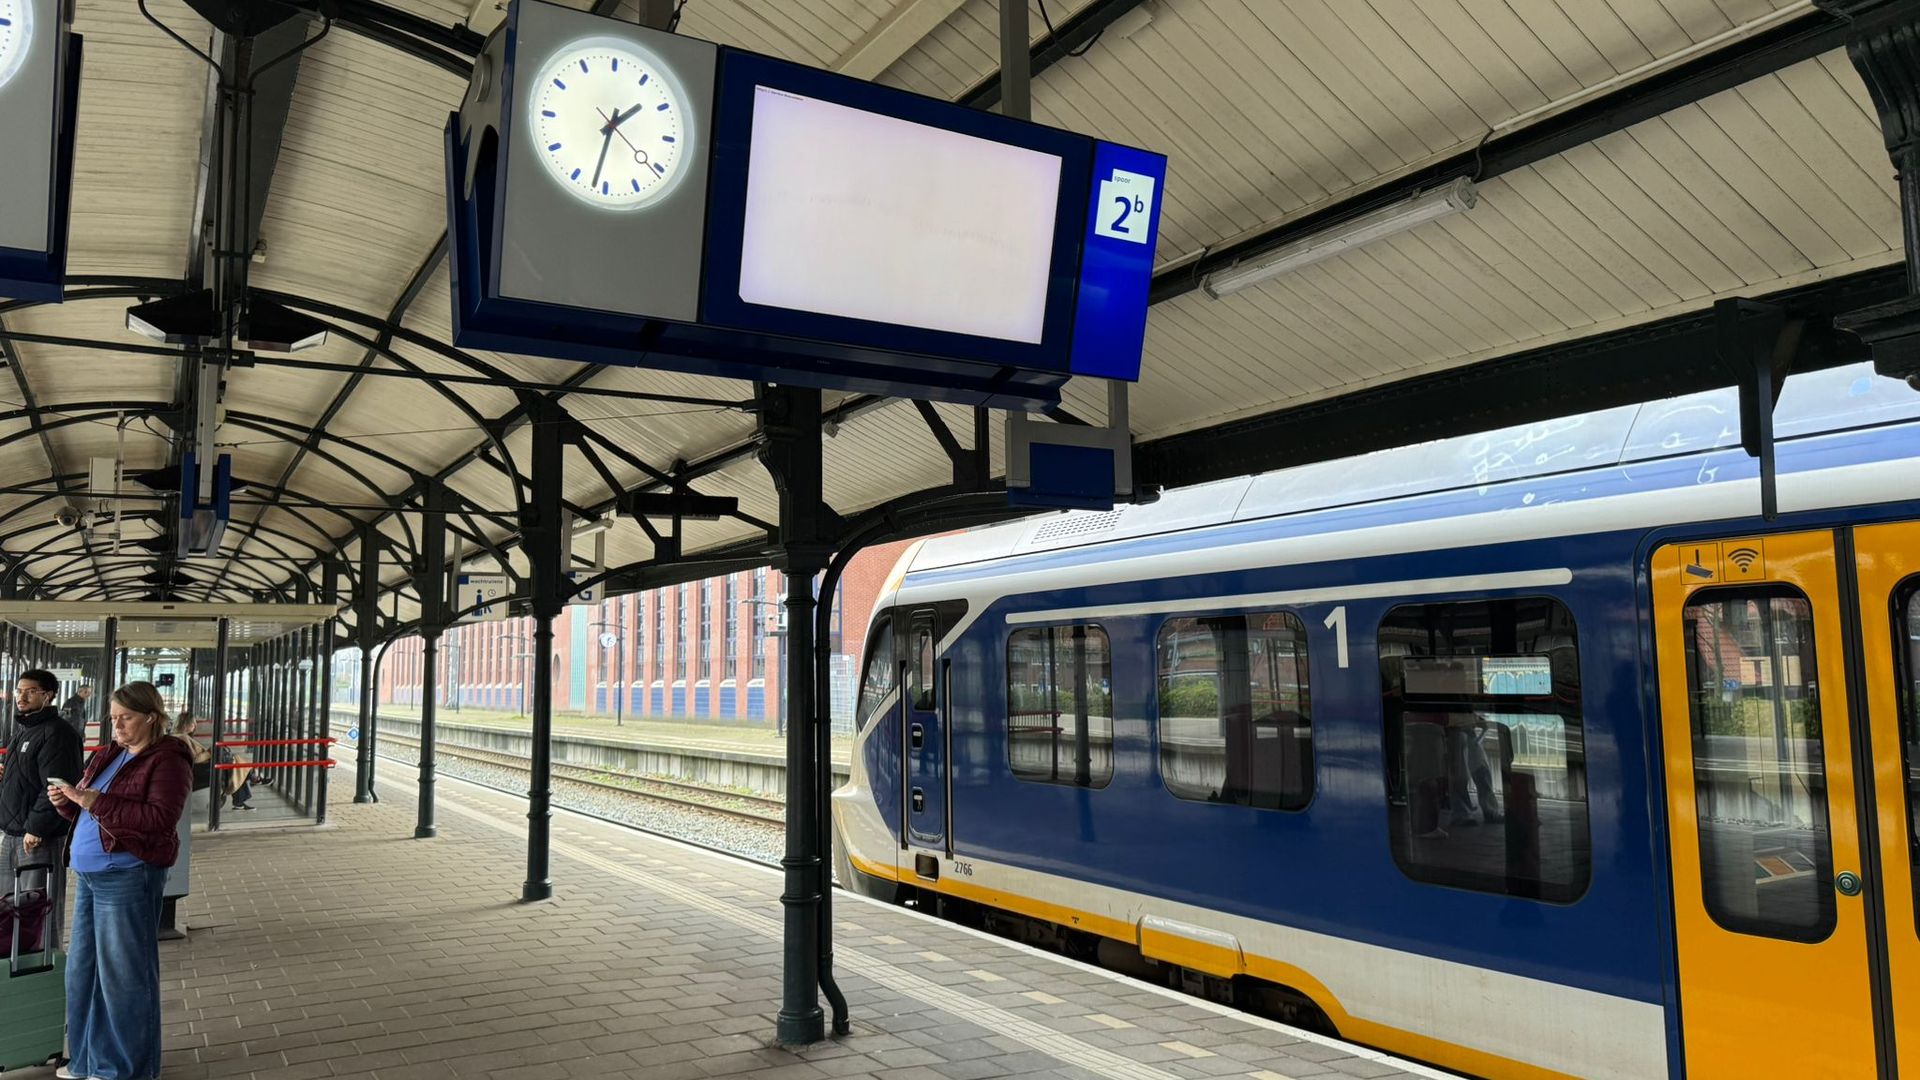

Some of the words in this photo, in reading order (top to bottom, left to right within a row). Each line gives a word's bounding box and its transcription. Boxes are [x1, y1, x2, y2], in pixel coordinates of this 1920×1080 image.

[1114, 176, 1131, 184] spoor
[1323, 605, 1349, 669] 1
[954, 861, 973, 876] 2766
